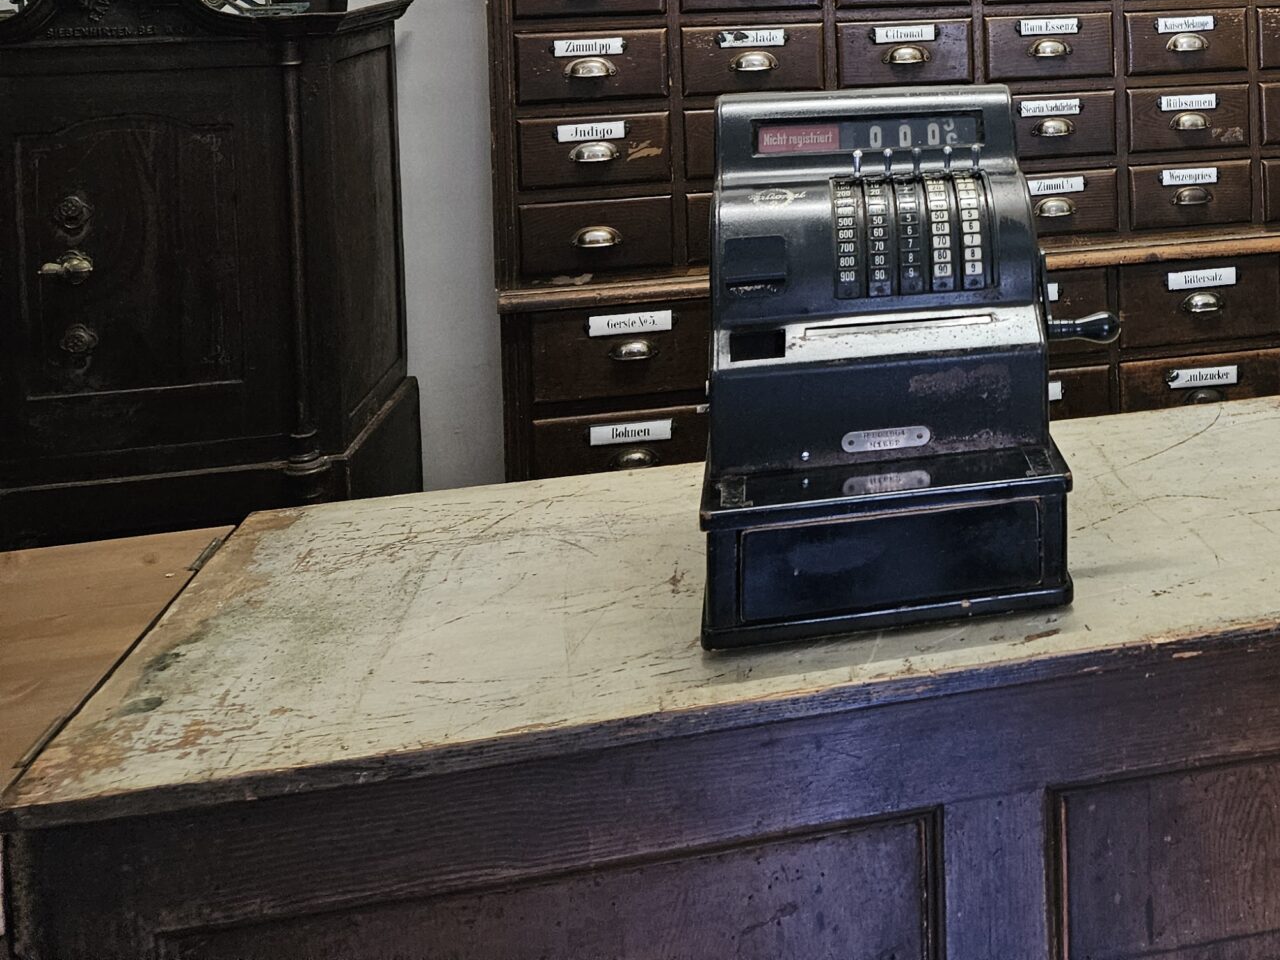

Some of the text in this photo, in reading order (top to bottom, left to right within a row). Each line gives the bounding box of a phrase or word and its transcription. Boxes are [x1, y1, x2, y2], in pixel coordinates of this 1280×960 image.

[1044, 20, 1075, 32] Essenz
[885, 28, 924, 39] Citronat
[1166, 97, 1213, 109] Rübsamen
[763, 130, 833, 147] Nicht registriert
[1169, 171, 1212, 183] Weizengries
[906, 214, 911, 222] 5
[934, 211, 944, 219] 50
[838, 217, 853, 226] 500
[872, 216, 882, 224] 50
[907, 226, 912, 235] 6
[935, 223, 945, 232] 60
[838, 229, 853, 238] 600
[873, 228, 883, 237] 60
[908, 239, 913, 248] 7
[937, 236, 946, 245] 70
[969, 235, 975, 243] 7
[839, 242, 854, 252] 700
[874, 241, 884, 250] 70
[937, 250, 947, 259] 80
[970, 248, 975, 257] 8
[839, 257, 855, 267] 800
[874, 255, 884, 265] 80
[908, 253, 913, 262] 8
[908, 267, 914, 277] 9
[937, 263, 948, 274] 90
[970, 263, 976, 272] 9
[840, 271, 855, 281] 900
[874, 269, 885, 280] 90
[1184, 273, 1223, 285] Bittersalz
[606, 318, 636, 330] Gerste
[611, 426, 651, 440] Bohnen
